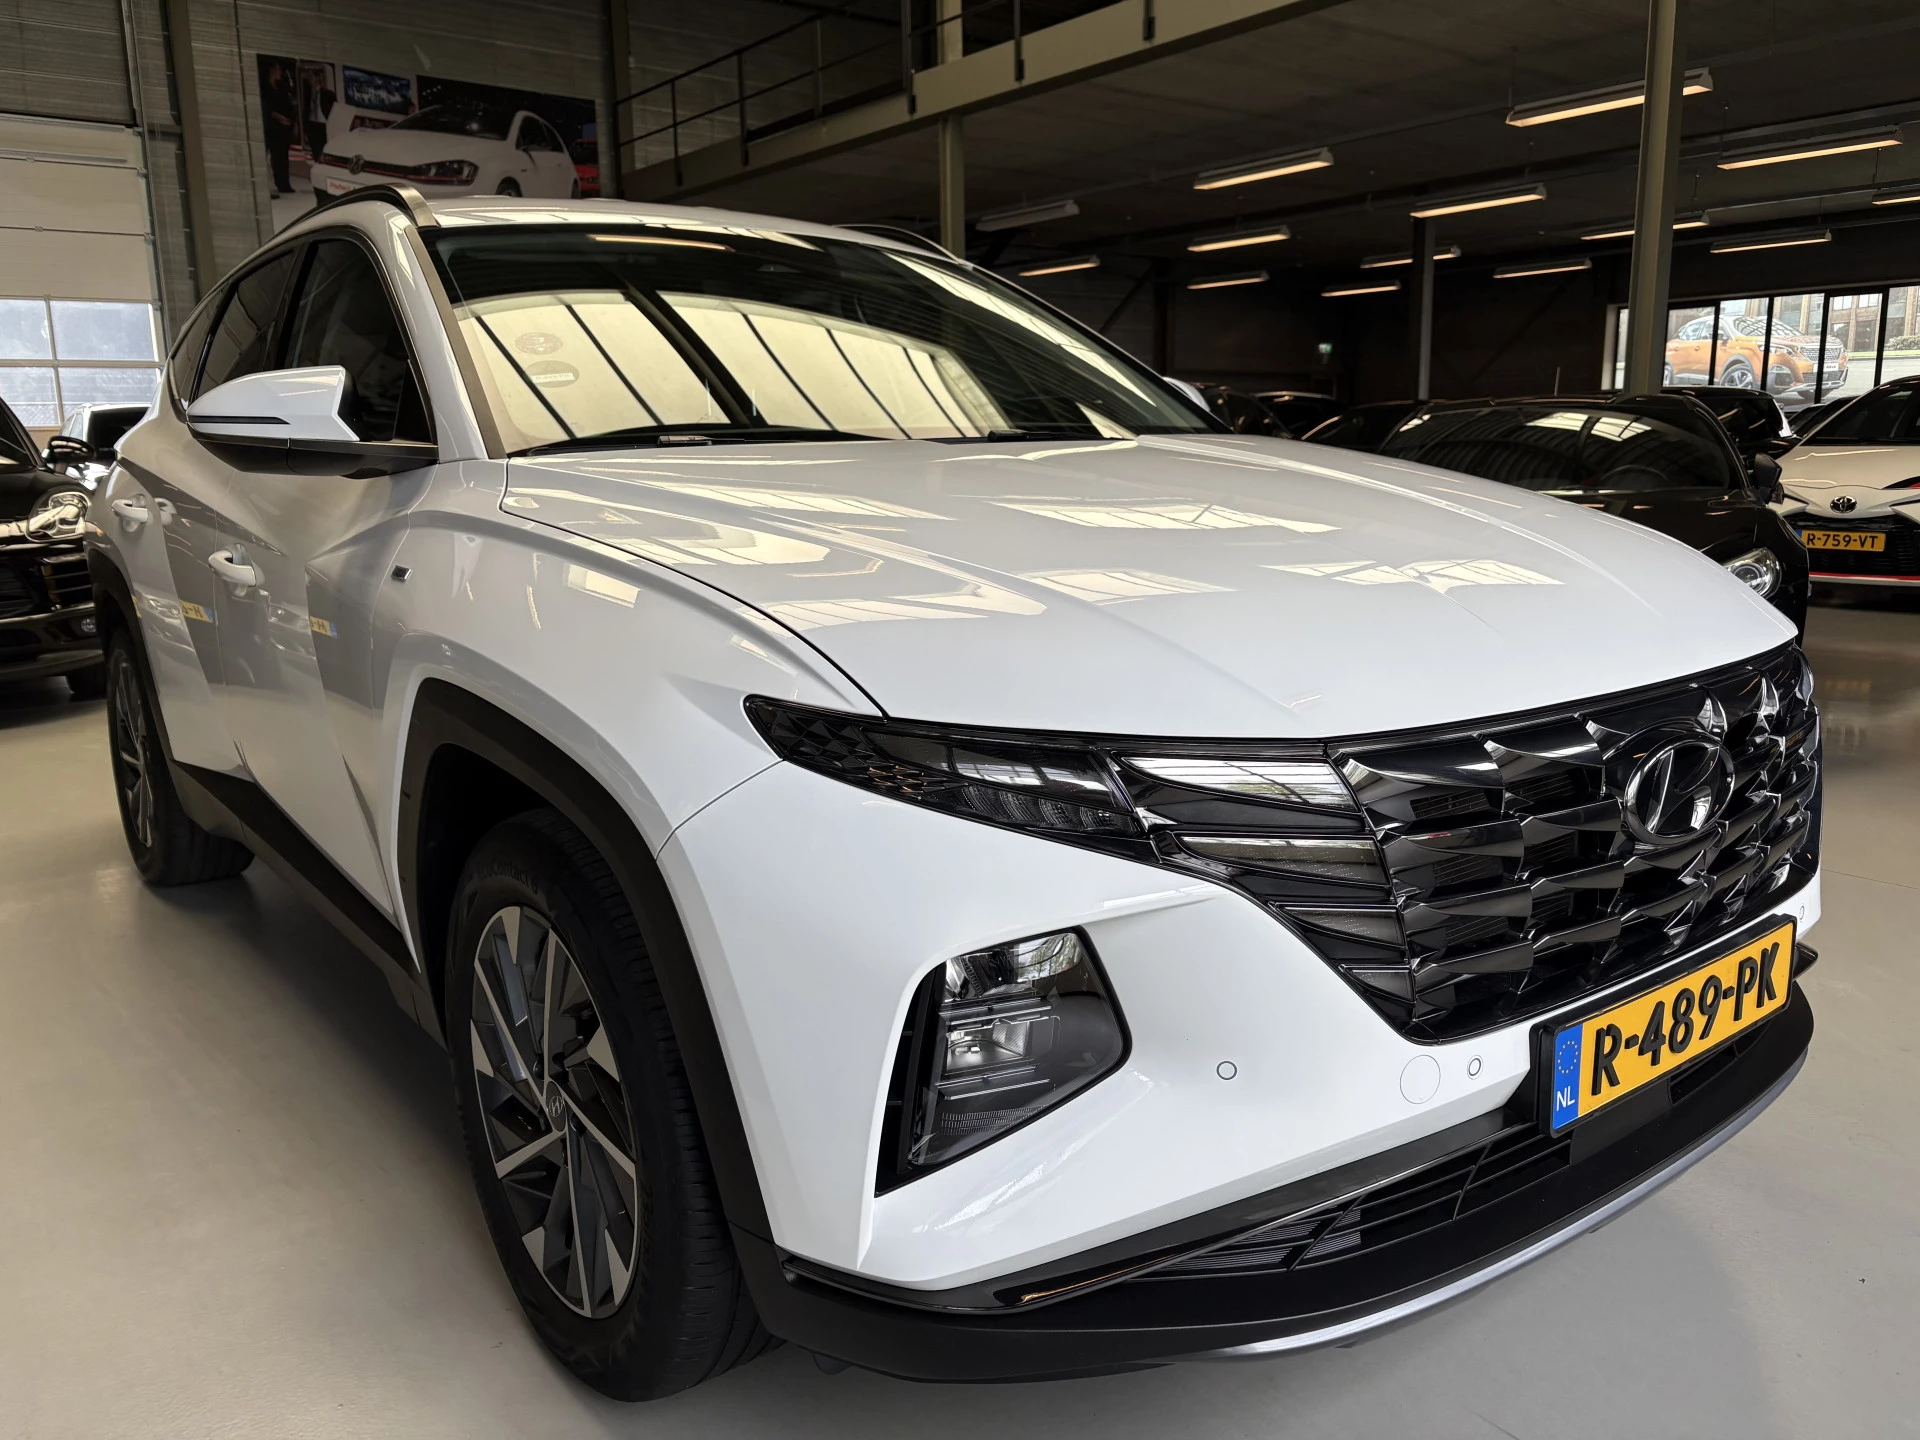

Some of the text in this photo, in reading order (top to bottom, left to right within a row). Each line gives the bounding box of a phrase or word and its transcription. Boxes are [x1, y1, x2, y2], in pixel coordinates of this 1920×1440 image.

[1807, 533, 1878, 548] R-759-VT
[1591, 942, 1780, 1096] R-489-PK
[1556, 1086, 1575, 1111] NL
